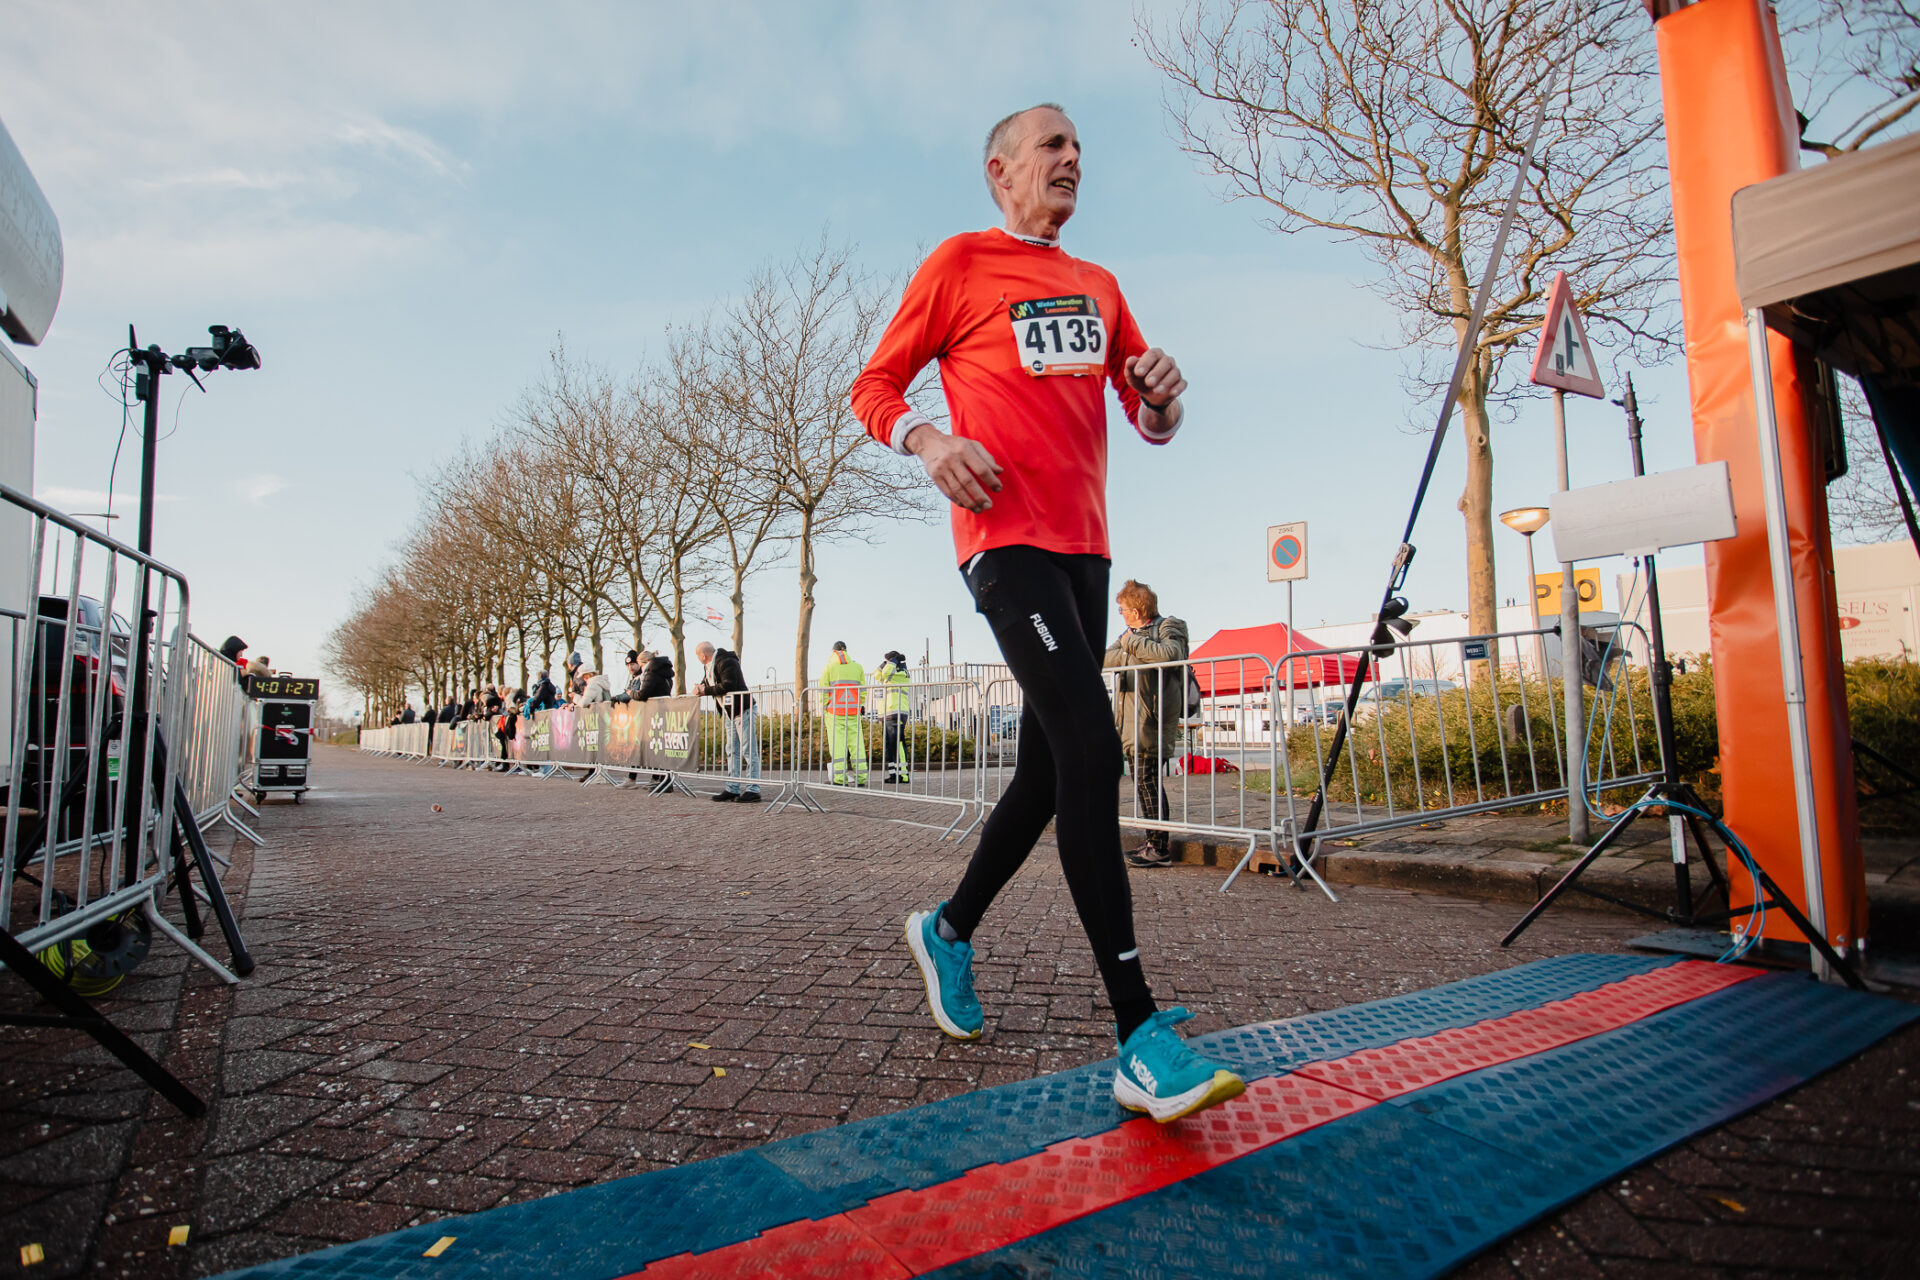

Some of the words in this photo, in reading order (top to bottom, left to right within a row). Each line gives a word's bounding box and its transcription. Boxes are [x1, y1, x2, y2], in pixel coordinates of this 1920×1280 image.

[1025, 319, 1101, 353] 4135
[1029, 612, 1058, 652] FUSION
[256, 681, 315, 695] 4:01:27
[665, 711, 690, 732] VALK
[664, 732, 689, 750] EVENT
[1129, 1053, 1158, 1097] HOKA
